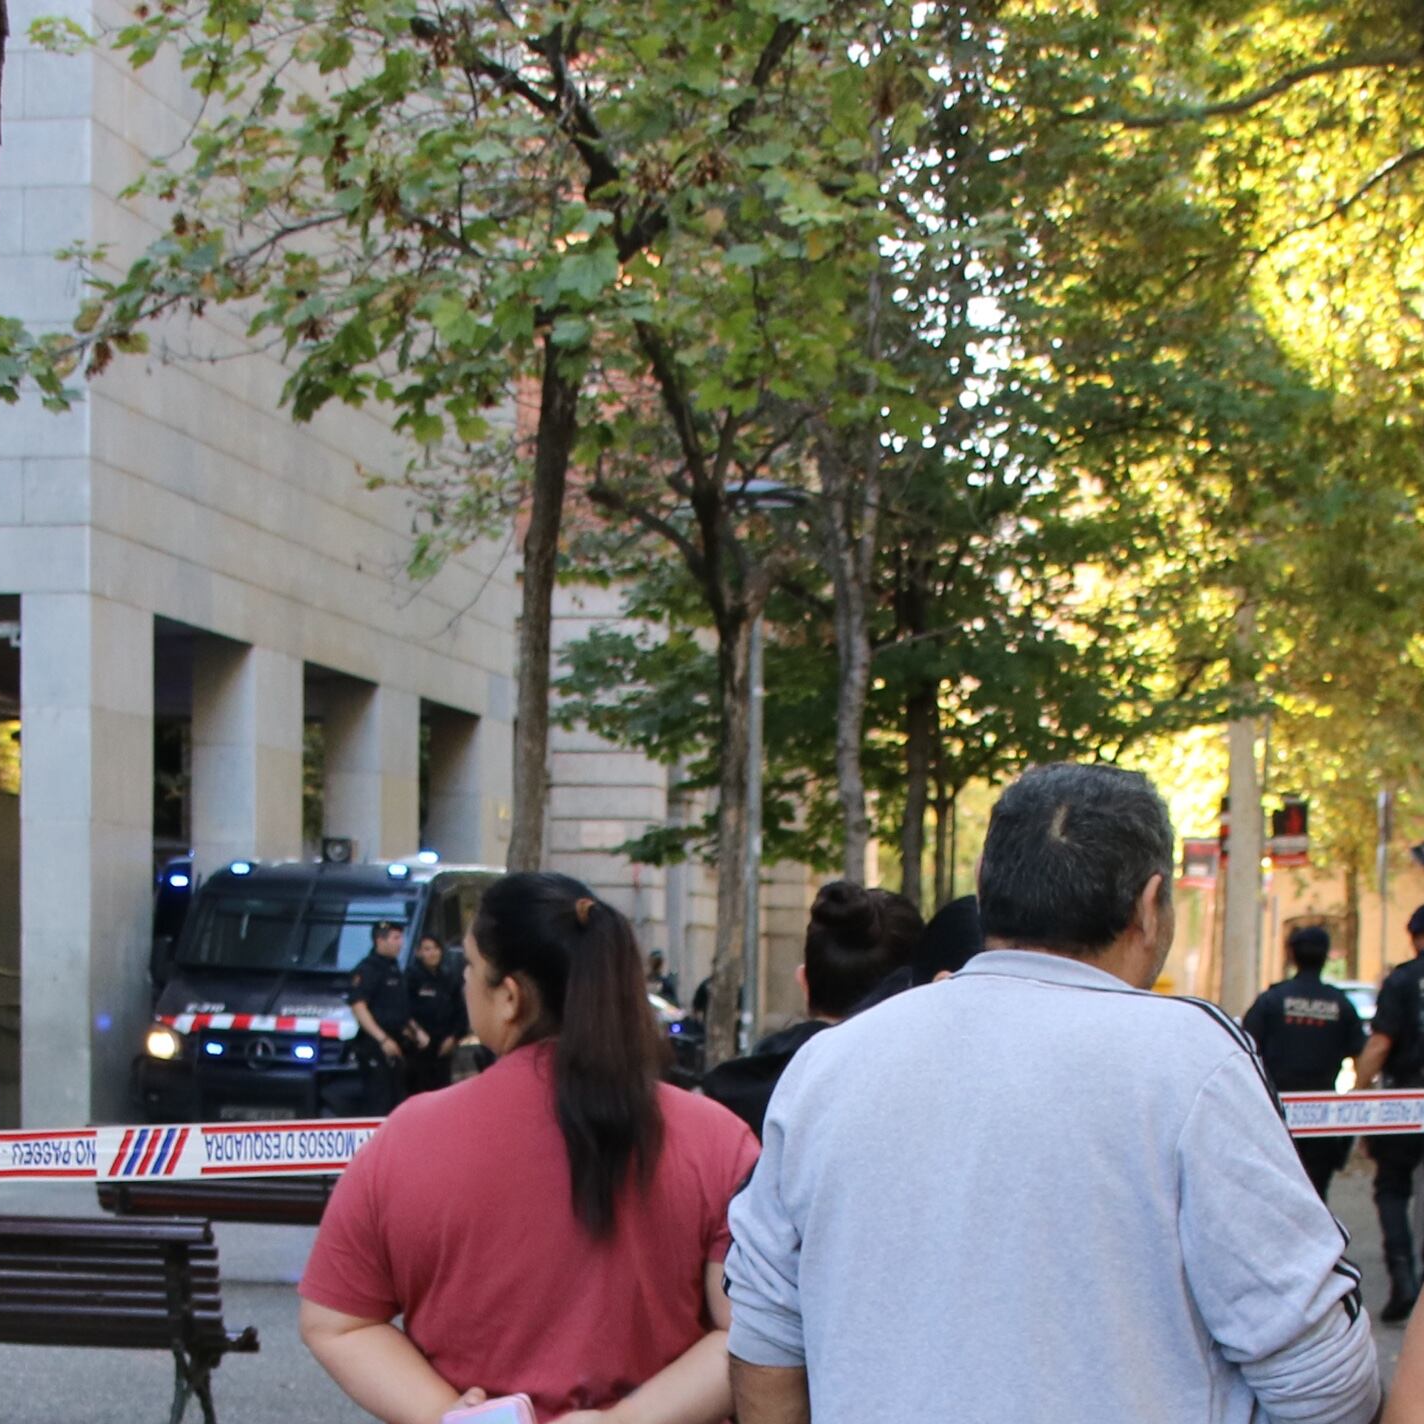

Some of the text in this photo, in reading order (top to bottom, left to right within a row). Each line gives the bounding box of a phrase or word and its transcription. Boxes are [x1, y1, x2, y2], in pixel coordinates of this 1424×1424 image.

[12, 1141, 72, 1166] PASSEU
[75, 1139, 97, 1165] NO
[205, 1130, 295, 1161] D'ESQUADRA
[298, 1129, 356, 1158] MOSSOS
